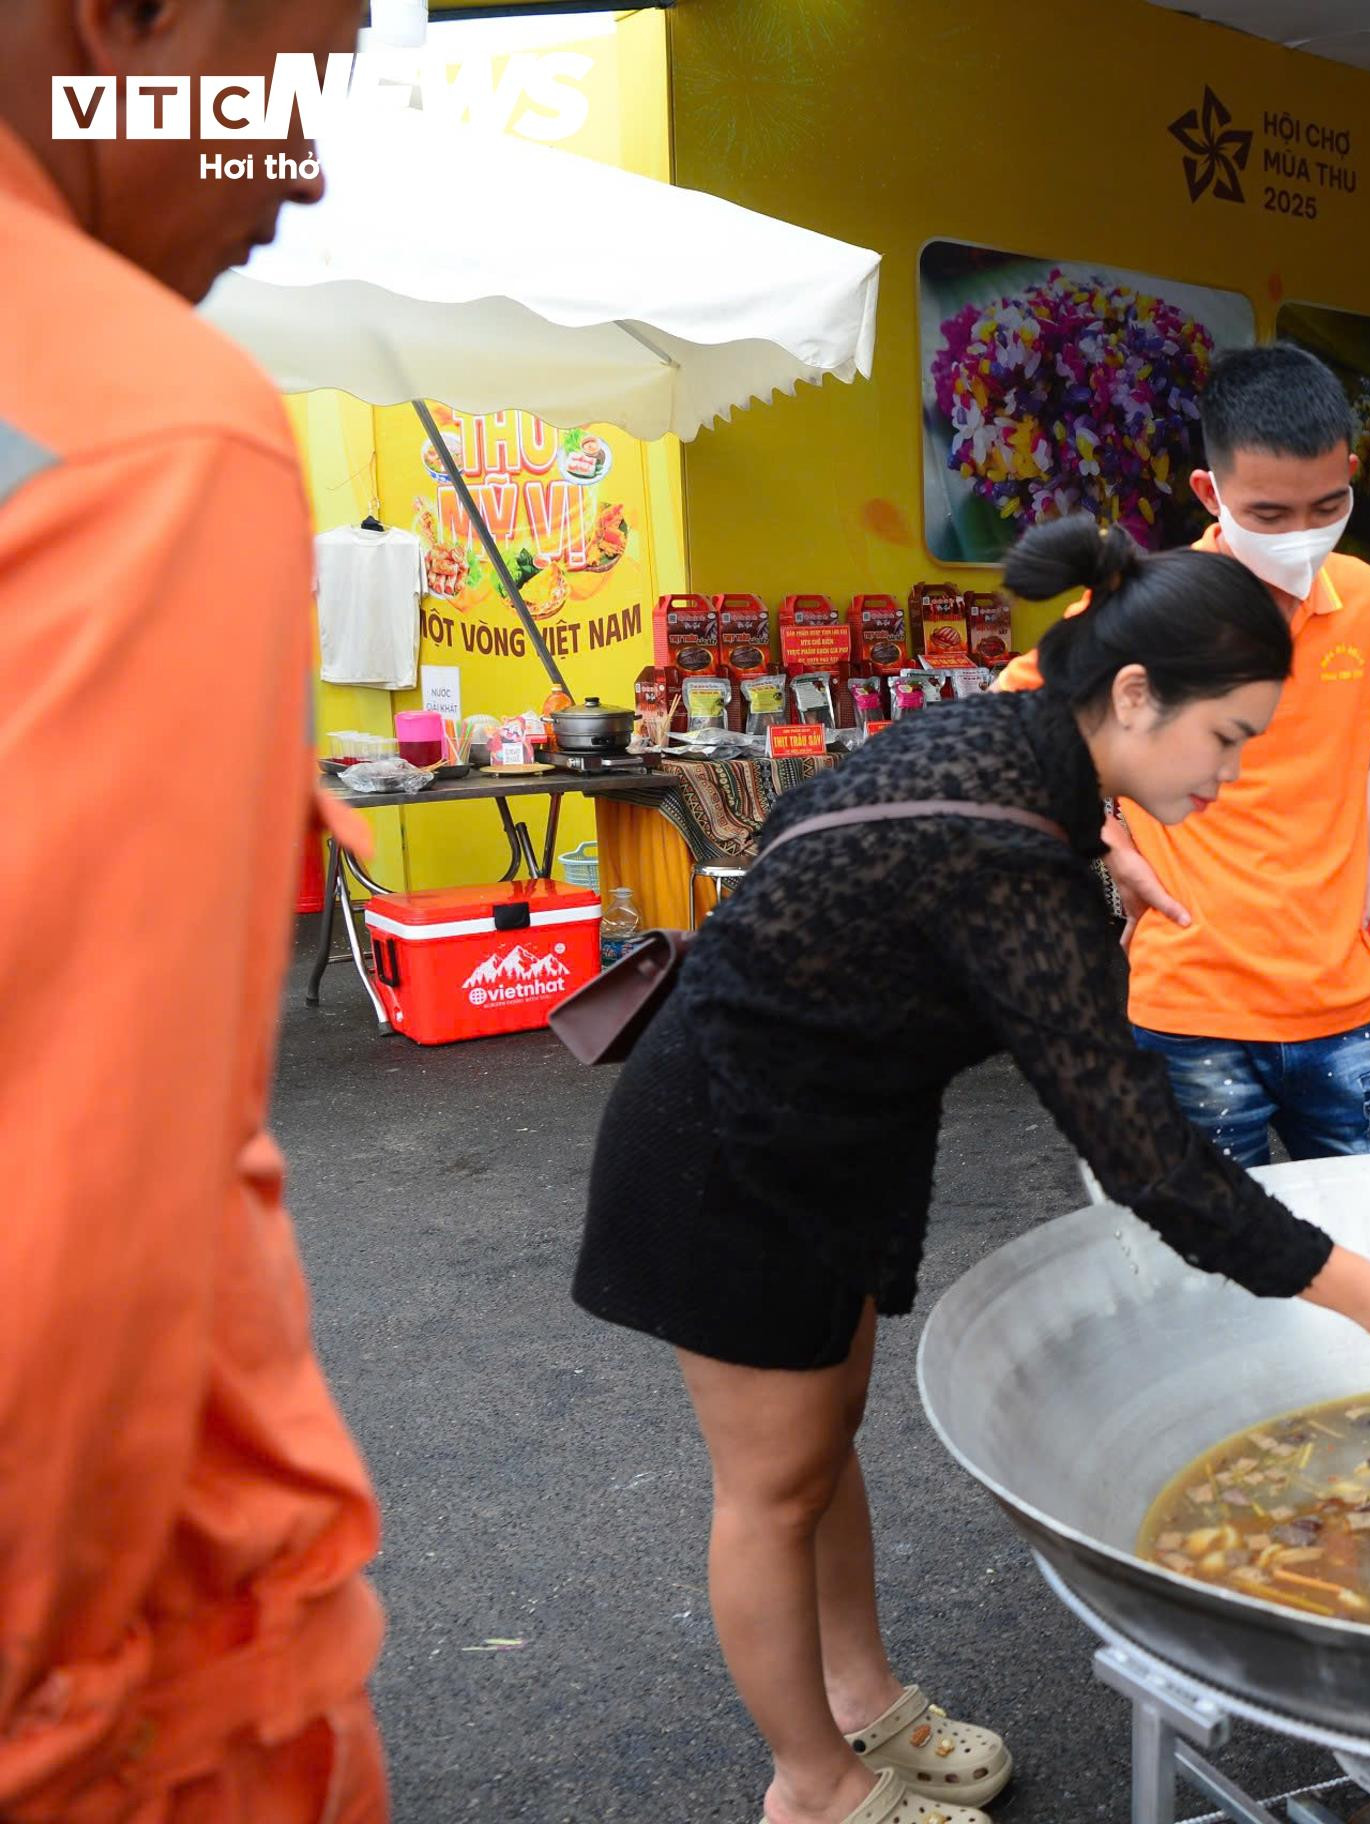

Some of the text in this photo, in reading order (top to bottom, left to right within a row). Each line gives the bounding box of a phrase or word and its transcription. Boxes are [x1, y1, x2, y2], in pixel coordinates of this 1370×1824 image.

[1264, 111, 1350, 160] HỘI CHỢ
[1264, 148, 1357, 193] MÙA THU
[1264, 186, 1317, 219] 2025
[525, 480, 587, 572] VỊ
[461, 620, 526, 658] VÒNG
[588, 603, 643, 650] NAM
[487, 977, 566, 1002] vietnhat
